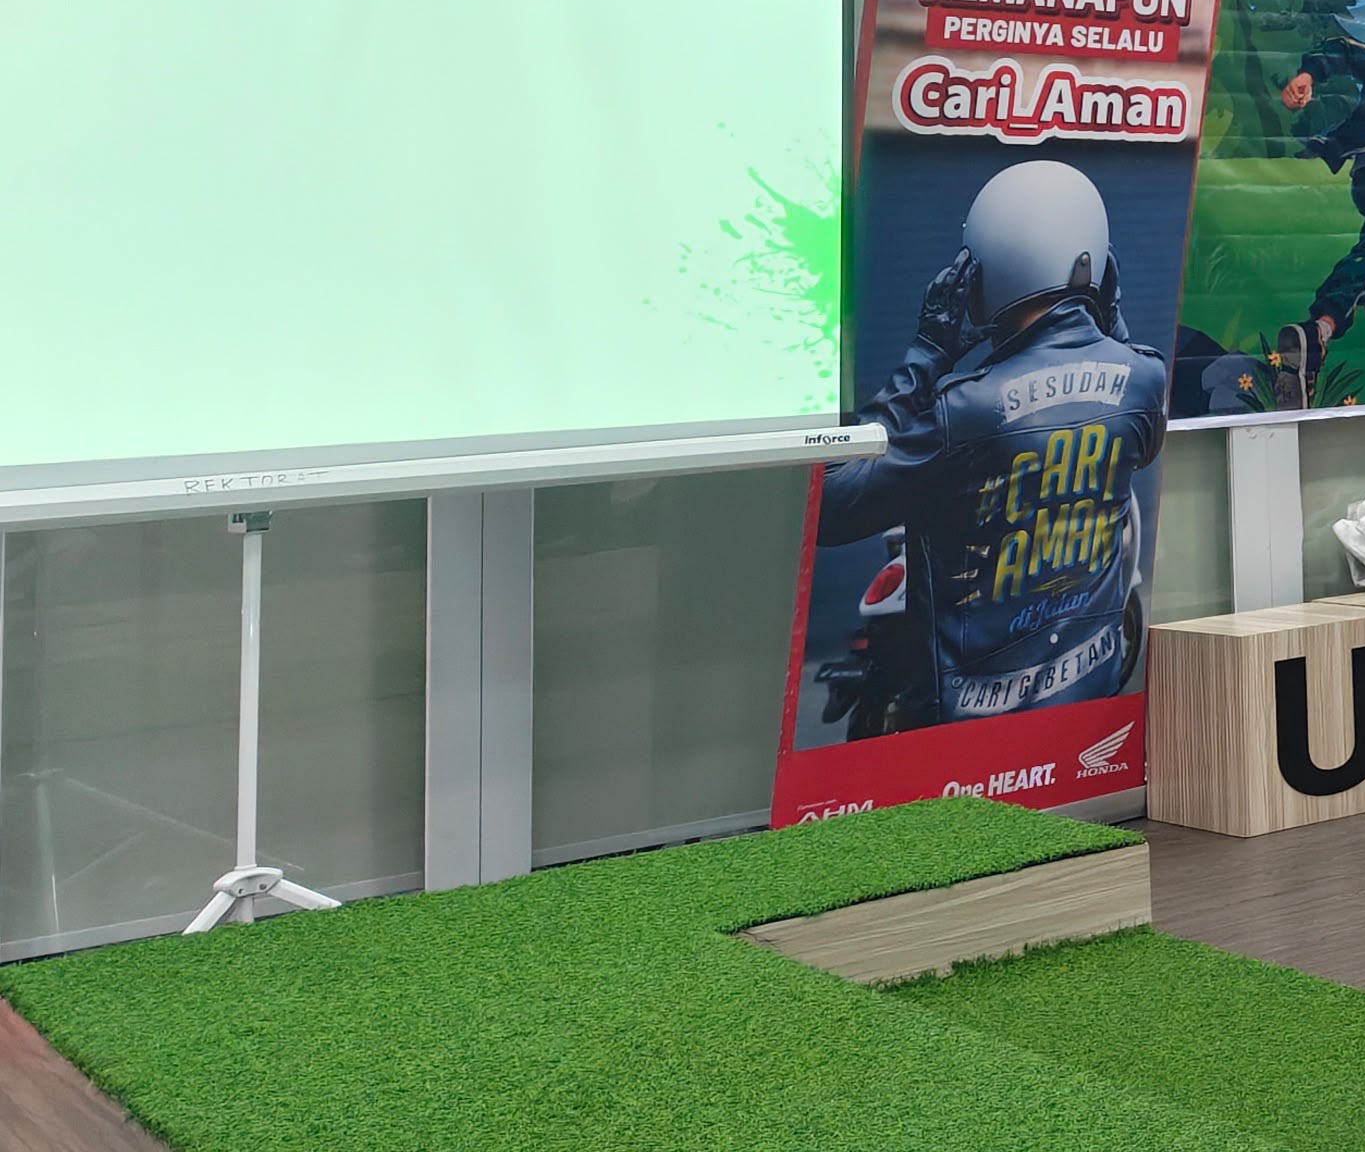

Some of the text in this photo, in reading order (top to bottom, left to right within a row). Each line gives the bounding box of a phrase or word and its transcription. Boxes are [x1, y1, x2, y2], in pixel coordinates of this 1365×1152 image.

[944, 16, 1164, 53] PERGINYA SELALU
[1007, 370, 1127, 411] SESUDAH
[993, 499, 1121, 603] AMAN
[988, 762, 1057, 798] HEART.
[1077, 762, 1129, 779] HONDA
